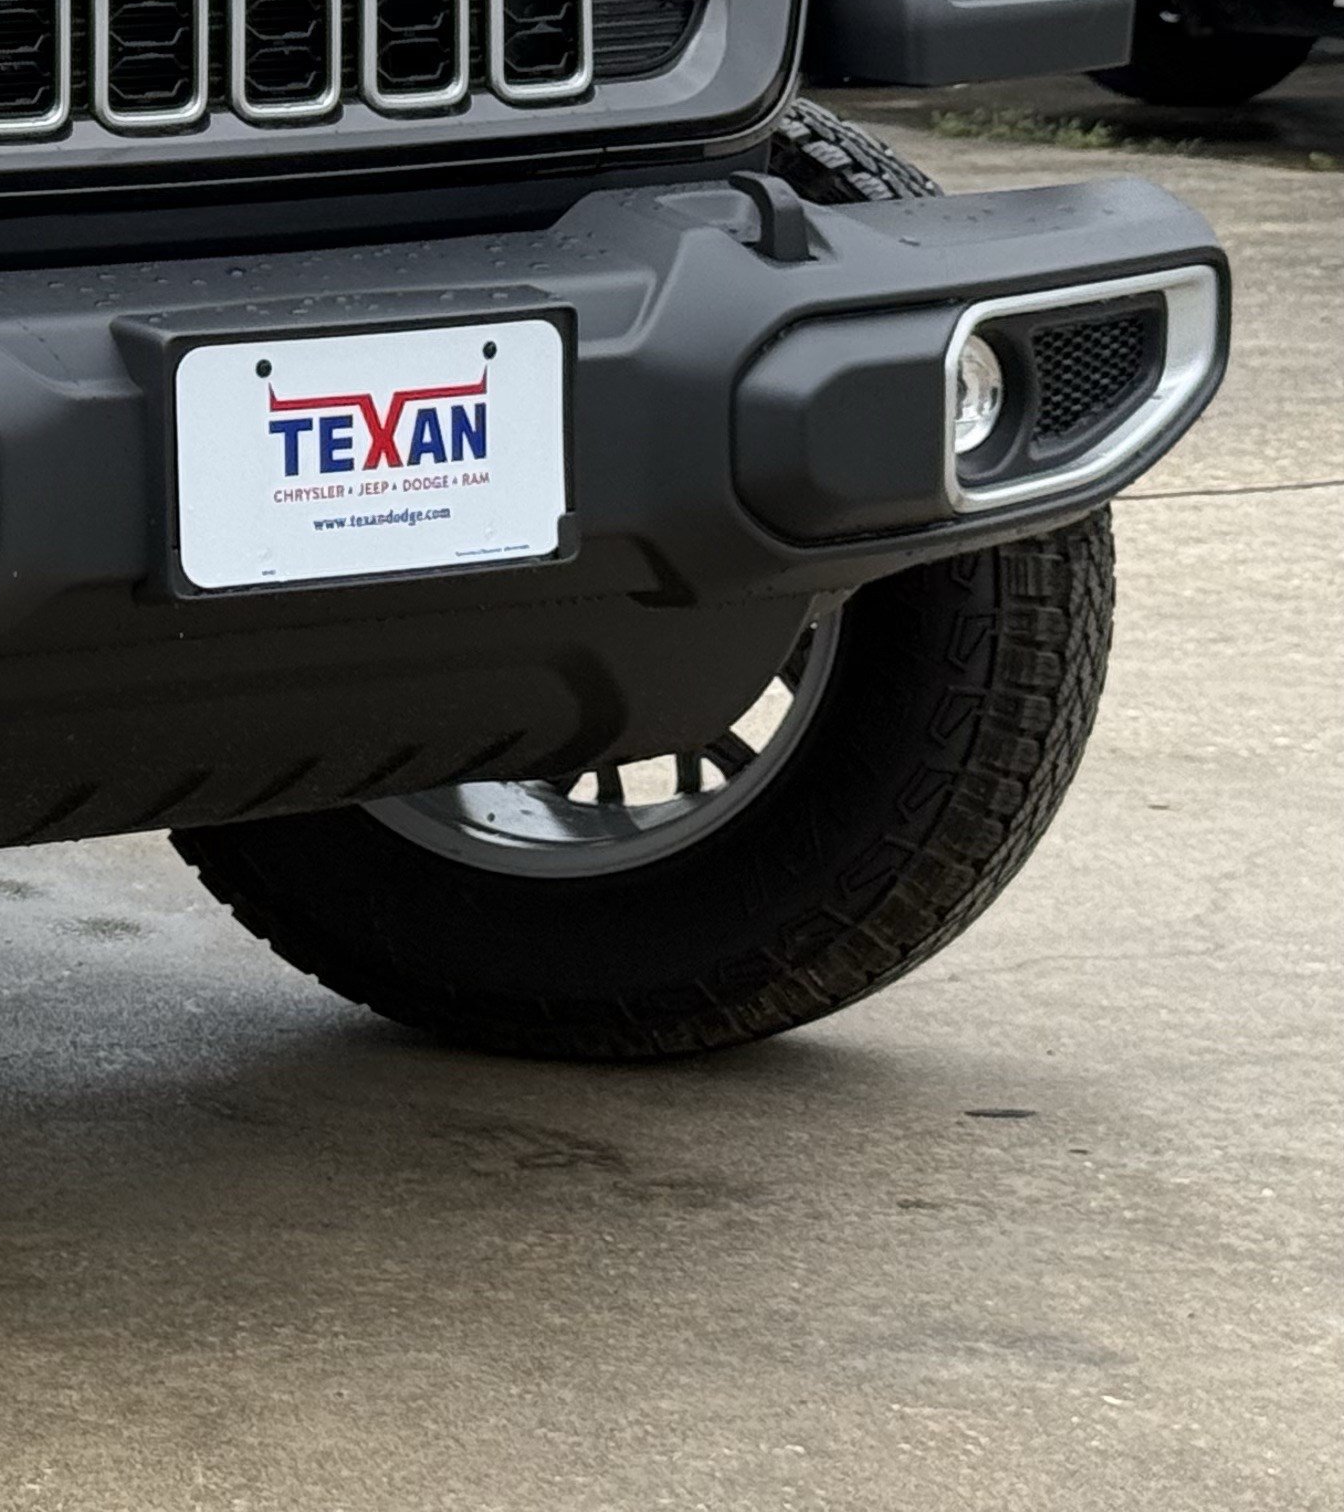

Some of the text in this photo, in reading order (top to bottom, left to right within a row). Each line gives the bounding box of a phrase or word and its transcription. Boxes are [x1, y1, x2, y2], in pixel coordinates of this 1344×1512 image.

[268, 384, 488, 477] TEXAN
[274, 473, 490, 503] CHRYSLER JEEP DODGE RAM
[313, 508, 451, 531] www.texandodge.com
